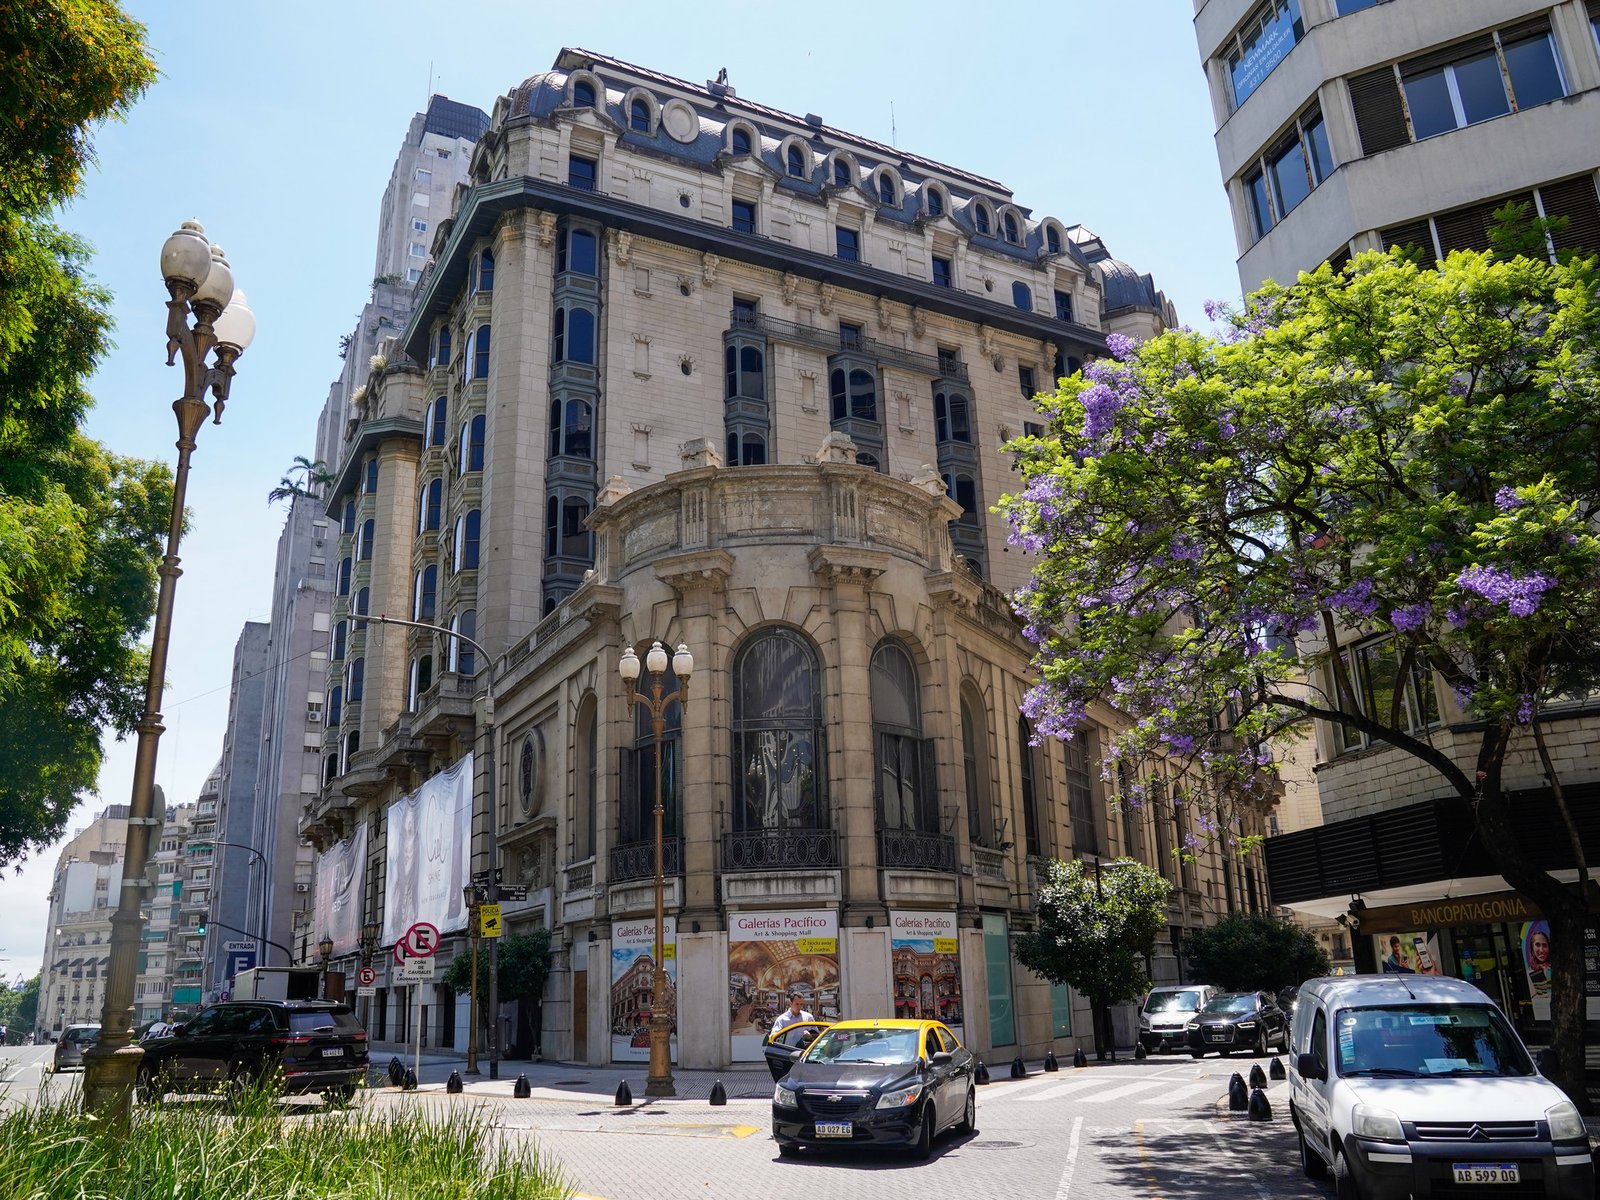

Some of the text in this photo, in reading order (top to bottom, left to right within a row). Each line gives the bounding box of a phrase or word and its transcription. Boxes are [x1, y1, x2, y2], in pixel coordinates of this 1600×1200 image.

[1243, 27, 1279, 71] NEWMARK
[1249, 50, 1282, 89] 4311 9500
[1412, 898, 1527, 925] BANCOPATAGONIA
[738, 916, 827, 930] Galerías Pacífico
[895, 916, 951, 928] Galerías Pacífico
[234, 957, 248, 974] E
[817, 1125, 851, 1134] AD 027 EG
[1458, 1170, 1472, 1181] AB
[1475, 1170, 1497, 1182] 599
